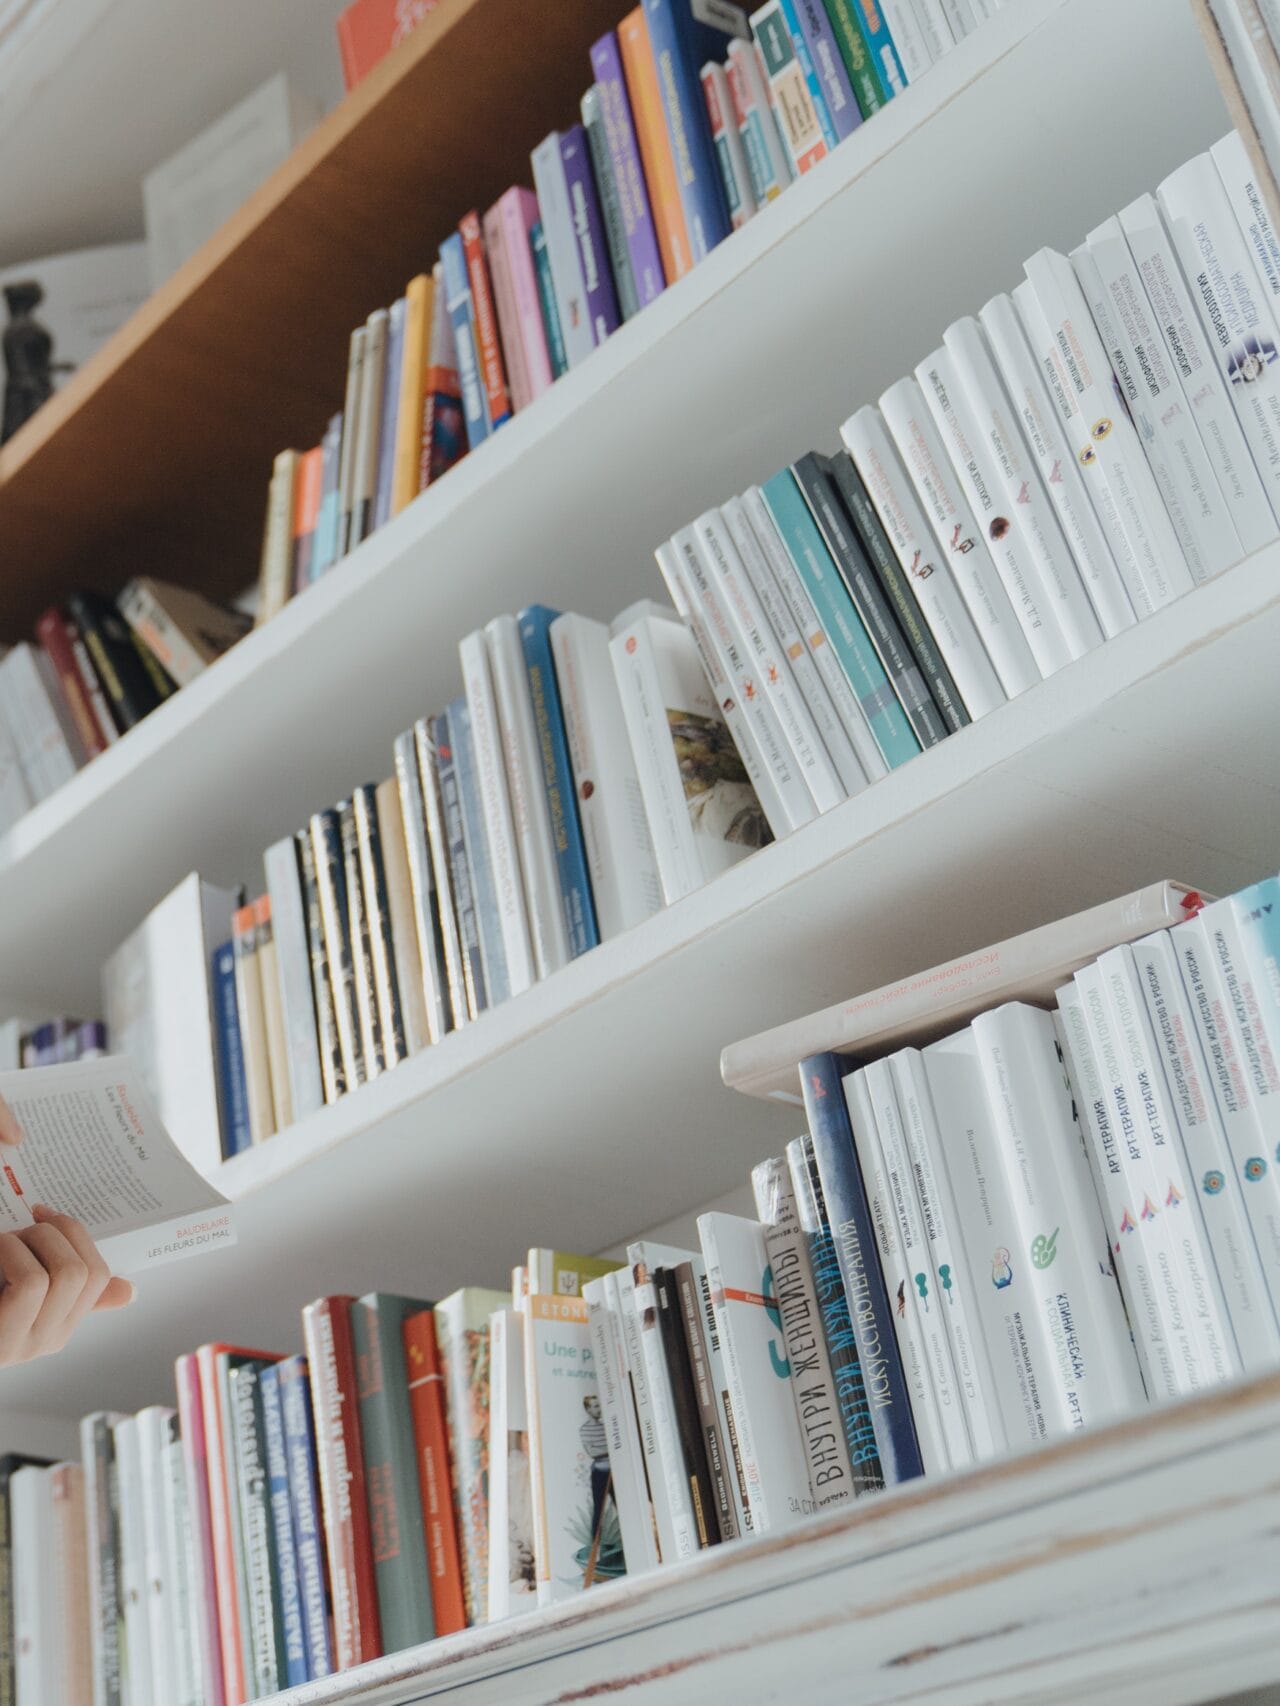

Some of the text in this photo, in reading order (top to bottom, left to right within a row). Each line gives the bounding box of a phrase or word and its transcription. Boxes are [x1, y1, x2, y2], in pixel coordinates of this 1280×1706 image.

[1117, 271, 1151, 338] ШИЗОФРЕНИКОВ
[1148, 252, 1182, 318] ШИЗОФРЕНИКОВ
[1191, 221, 1242, 329] ПСИХОСОМАТИЧЕСКАЯ
[1227, 270, 1261, 329] МЕДИЦИНА
[1194, 271, 1232, 348] НЕВРОЗОЛОГИЯ
[1111, 348, 1141, 400] ПСИХИЧЕСКИЙ
[1132, 343, 1162, 397] ШИЗОФРЕНИЯ
[1144, 342, 1171, 389] ШИЗОИДОВ
[1163, 323, 1193, 377] ШИЗОФРЕНИЯ
[1176, 323, 1202, 371] ШИЗОИДОВ
[927, 367, 952, 411] ПОВЕДЕНИЯ
[965, 459, 994, 510] ПСИХОЛОГИЯ
[1192, 982, 1220, 1041] ИСКУССТВО
[1222, 963, 1250, 1023] ИСКУССТВО
[1152, 997, 1179, 1057] ИСКУССТВО
[1209, 1040, 1240, 1112] АУТСАЙДЕРСКОЕ
[1239, 1022, 1270, 1096] АУТСАЙДЕРСКОЕ
[1135, 1067, 1167, 1147] АРТ-ТЕРАПИЯ:
[1168, 1055, 1199, 1127] АУТСАЙДЕРСКОЕ
[1091, 1096, 1123, 1174] АРТ-ТЕРАПИЯ:
[1111, 1081, 1144, 1161] АРТ-ТЕРАПИЯ:
[146, 1246, 162, 1258] LES
[162, 1237, 194, 1253] FLEURS
[211, 1228, 230, 1240] MAL
[175, 1215, 230, 1239] BAUDELAIRE
[899, 1213, 913, 1248] МУЗЫКА
[923, 1206, 938, 1240] МУЗЫКА
[698, 1273, 711, 1301] BACK
[704, 1302, 717, 1331] ROAD
[769, 1246, 820, 1376] ЖЕНЩИНЫ
[836, 1217, 894, 1409] ИСКУССТВОТЕРАПИЯ
[543, 1341, 577, 1358] Une
[1011, 1311, 1033, 1373] МУЗЫКАЛЬНАЯ
[1055, 1293, 1086, 1379] КЛИНИЧЕСКАЯ
[1155, 1345, 1180, 1397] тория
[608, 1414, 622, 1449] Balzac
[642, 1416, 657, 1455] Balzac
[722, 1396, 737, 1445] REMARQUE
[797, 1383, 843, 1486] ВНУТРИ
[833, 1360, 878, 1466] ВНУТРИ
[707, 1430, 721, 1470] ORWELL
